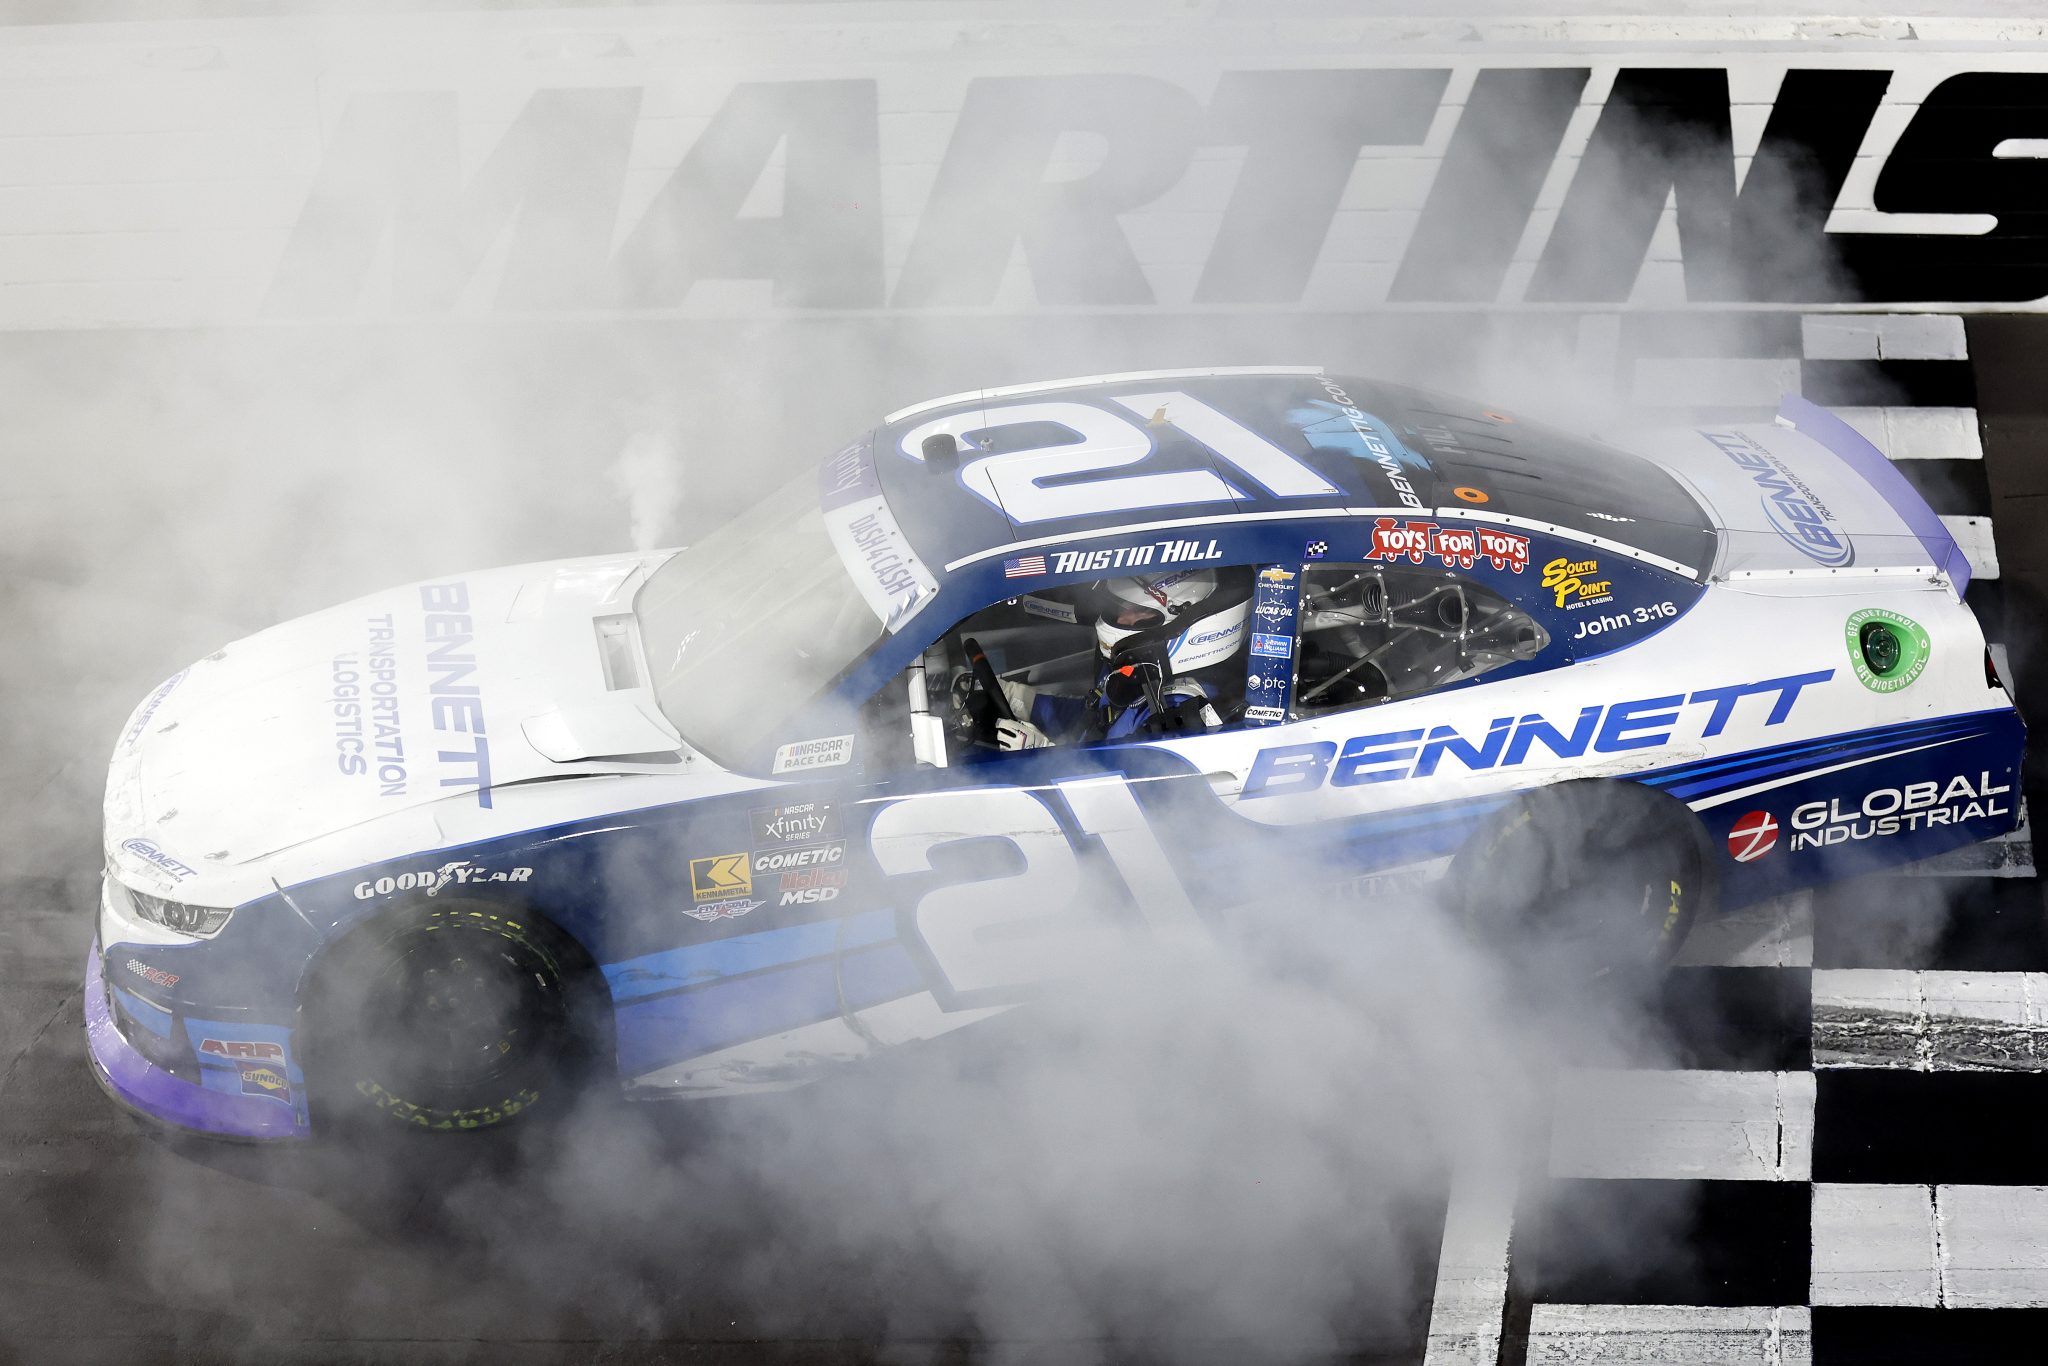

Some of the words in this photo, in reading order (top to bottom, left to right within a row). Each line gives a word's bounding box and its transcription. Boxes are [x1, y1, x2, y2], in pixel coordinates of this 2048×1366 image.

[256, 67, 2048, 313] MARTINS
[899, 390, 1342, 525] 21
[1692, 429, 1843, 550] BENNETT
[849, 513, 887, 552] DASH
[1378, 531, 1427, 550] TOYS
[1439, 534, 1473, 551] FOR
[1481, 535, 1526, 559] TOTS
[866, 546, 892, 561] 4
[1050, 546, 1156, 574] AUSTIN
[1156, 540, 1223, 563] HILL
[870, 554, 916, 596] CASH
[1541, 558, 1598, 587] SOUTH
[1258, 582, 1295, 591] CHEVROLET
[1553, 577, 1612, 608] POINT
[1255, 606, 1279, 615] LUCAS
[1279, 608, 1294, 617] OIL
[1566, 602, 1585, 611] HOTEL
[1592, 596, 1614, 605] CASINO
[1574, 614, 1632, 639] John
[1633, 601, 1678, 624] 3:16
[1847, 621, 1859, 637] GET
[1852, 609, 1916, 631] BIOETHANOL
[1264, 677, 1287, 690] ptc
[1857, 664, 1872, 683] GET
[1871, 655, 1927, 691] BIOETHANOL
[418, 581, 493, 810] BENNETT
[332, 660, 367, 776] LOGISTICS
[1247, 708, 1283, 718] COMETIC
[1240, 668, 1835, 800] BENNETT
[799, 739, 843, 755] NASCAR
[784, 757, 815, 768] RACE
[817, 752, 841, 763] CAR
[784, 804, 815, 815] NASCAR
[1790, 770, 2010, 830] GLOBAL
[765, 814, 827, 839] xfinity
[785, 832, 810, 841] SERIES
[1790, 799, 2009, 852] INDUSTRIAL
[128, 842, 197, 876] BENNETT
[755, 846, 842, 871] COMETIC
[354, 864, 533, 900] GOODYEAR
[779, 868, 848, 892] Holley
[868, 772, 1218, 993] 21
[696, 886, 748, 900] KENNAMETAL
[779, 887, 840, 906] MSD
[145, 966, 180, 988] RCR
[199, 1038, 286, 1061] ARP
[243, 1070, 288, 1090] SUNOCO
